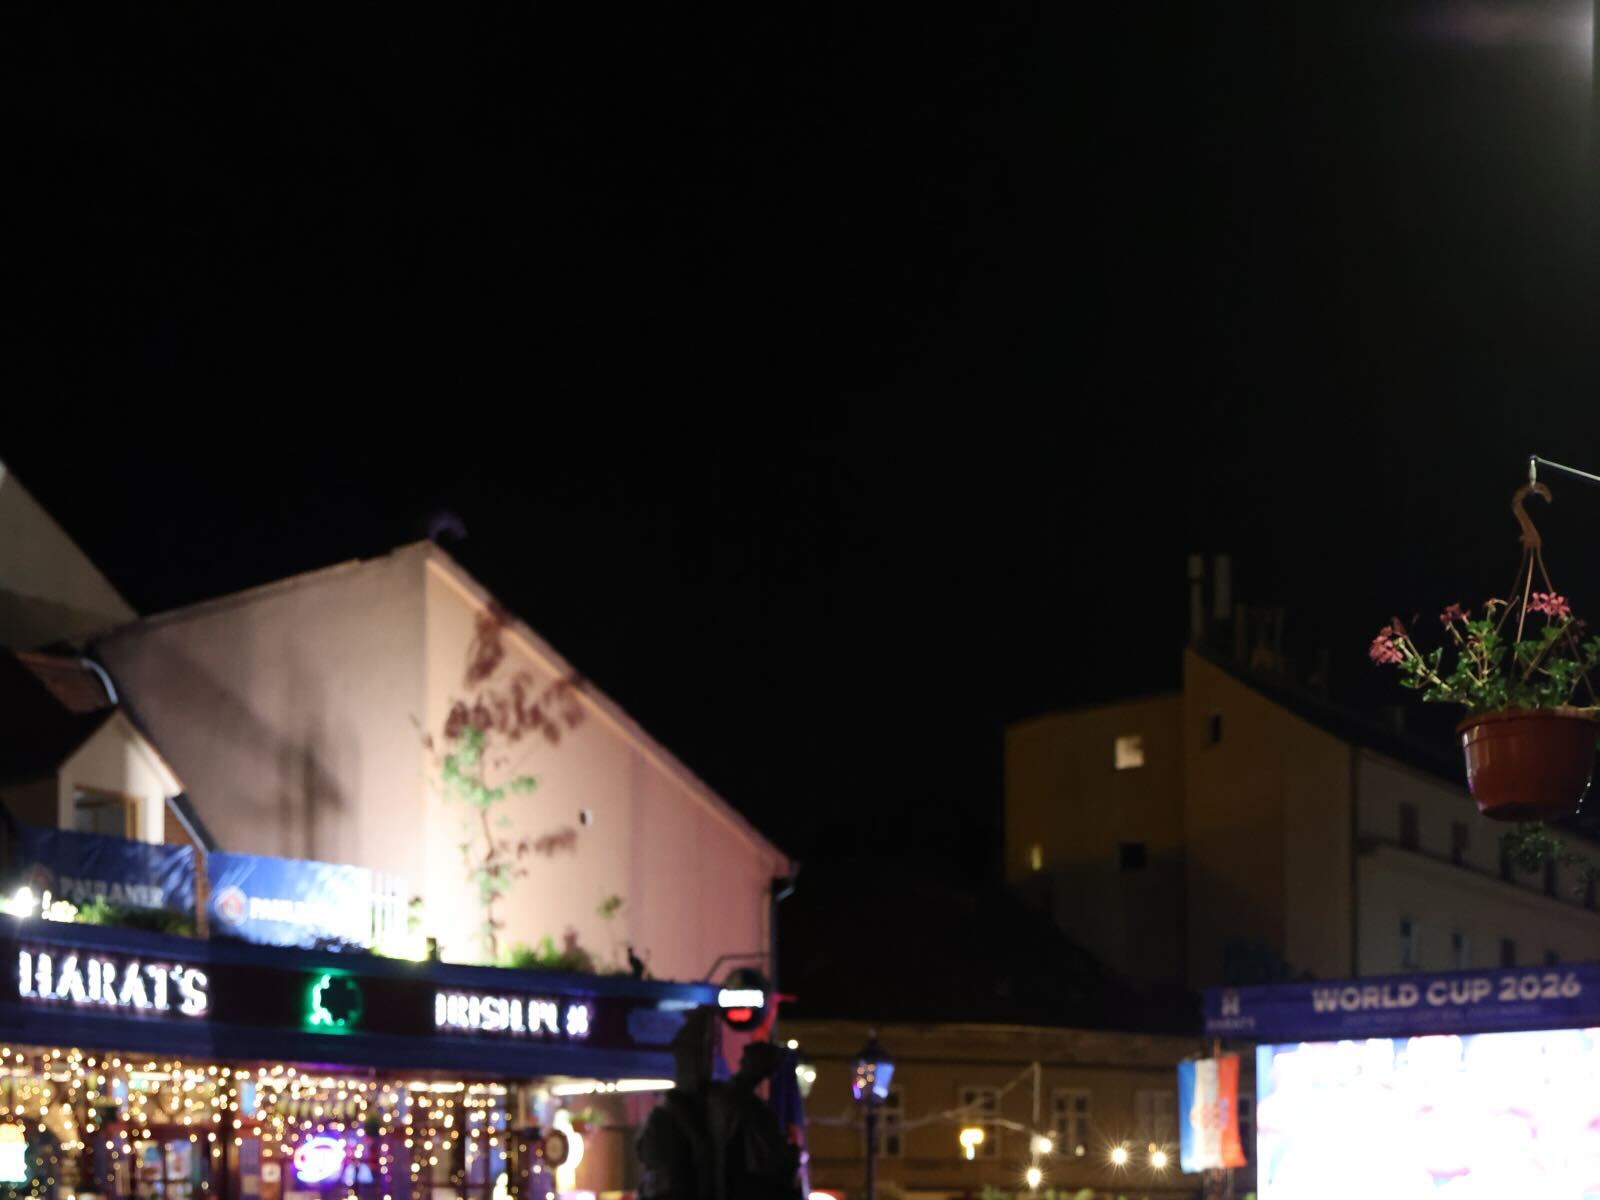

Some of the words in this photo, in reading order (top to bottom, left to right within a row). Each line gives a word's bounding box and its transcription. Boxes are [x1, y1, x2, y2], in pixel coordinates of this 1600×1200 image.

[19, 950, 208, 1016] HARAT'S
[1312, 983, 1420, 1013] WORLD
[1426, 978, 1493, 1006] CUP
[1498, 972, 1581, 1001] 2026
